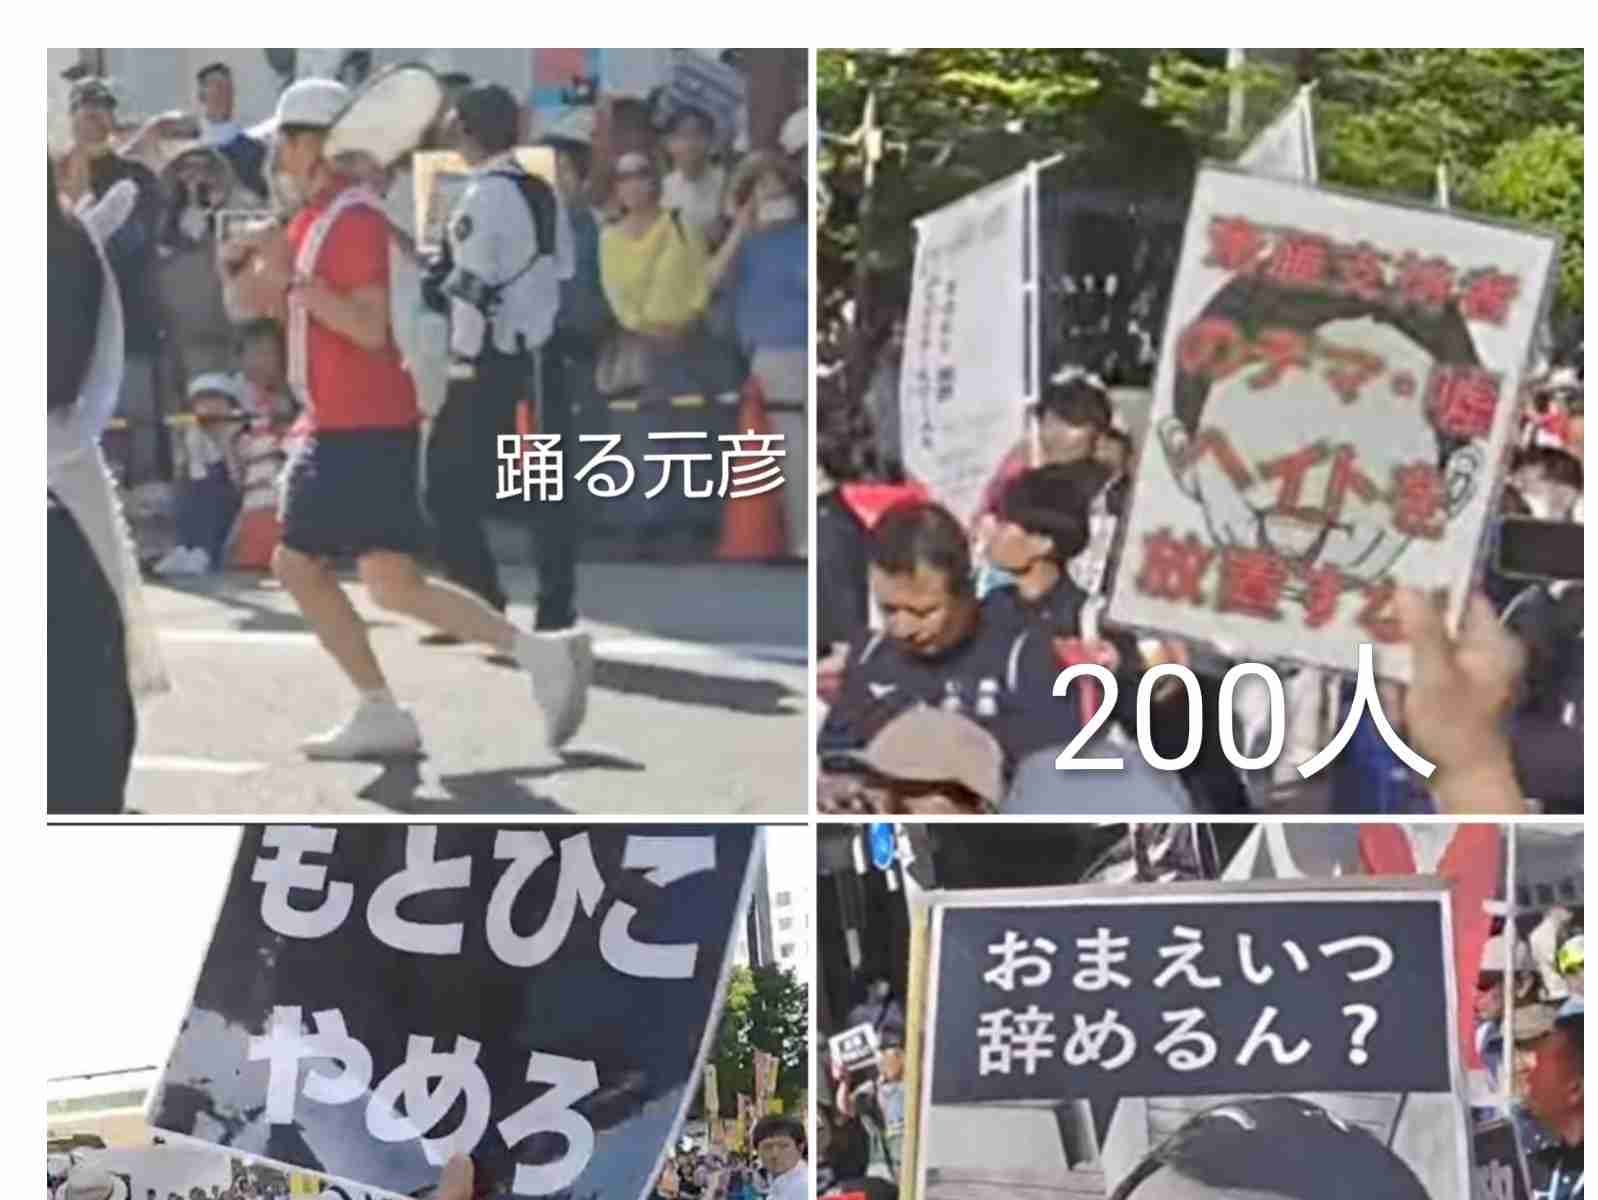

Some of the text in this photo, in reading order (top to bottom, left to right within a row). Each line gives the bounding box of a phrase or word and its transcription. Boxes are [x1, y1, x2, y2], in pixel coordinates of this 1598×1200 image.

[251, 823, 717, 980] もとひこ
[981, 924, 1396, 994] おまえいつ
[975, 1003, 1382, 1077] 辞めるん？
[247, 1003, 601, 1198] やめろ
